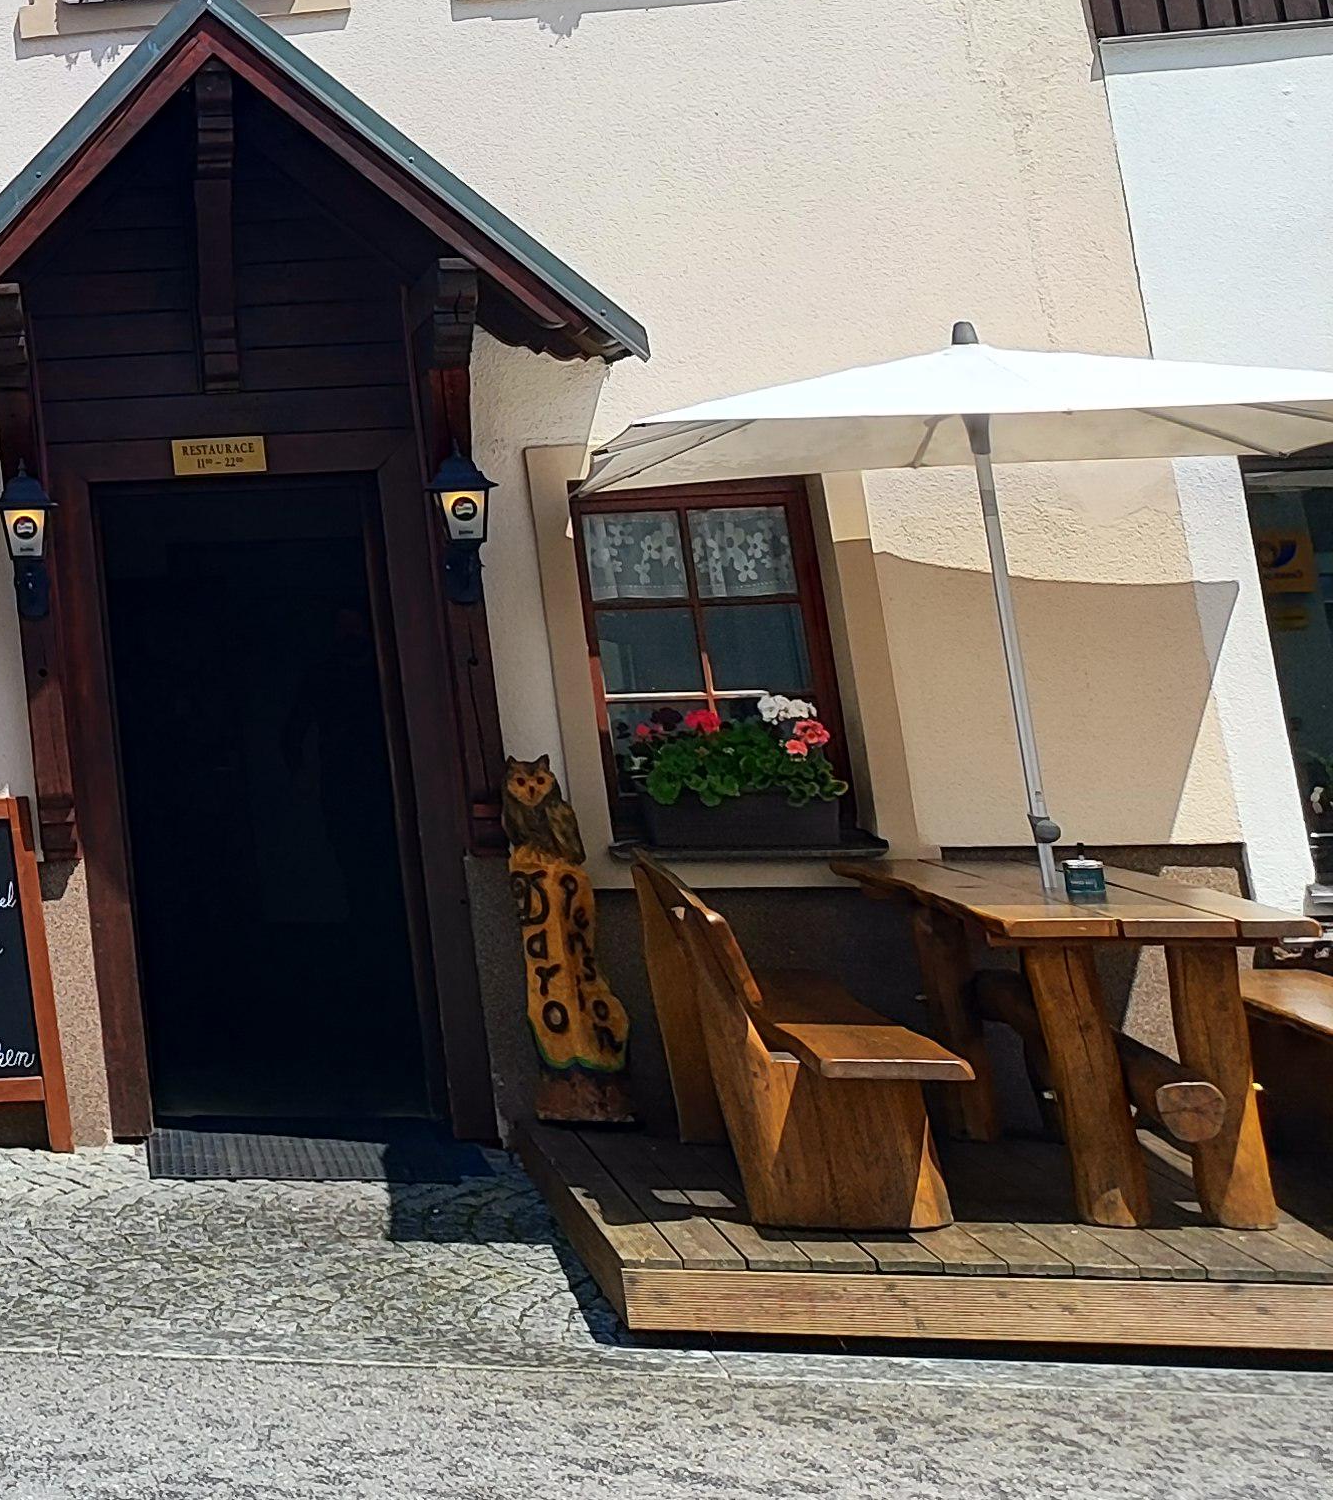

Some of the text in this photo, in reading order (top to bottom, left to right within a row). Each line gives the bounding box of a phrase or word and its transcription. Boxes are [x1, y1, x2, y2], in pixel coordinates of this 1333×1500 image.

[181, 442, 255, 456] RESTAURACE
[510, 869, 570, 1035] Daro
[559, 872, 624, 1054] Pension
